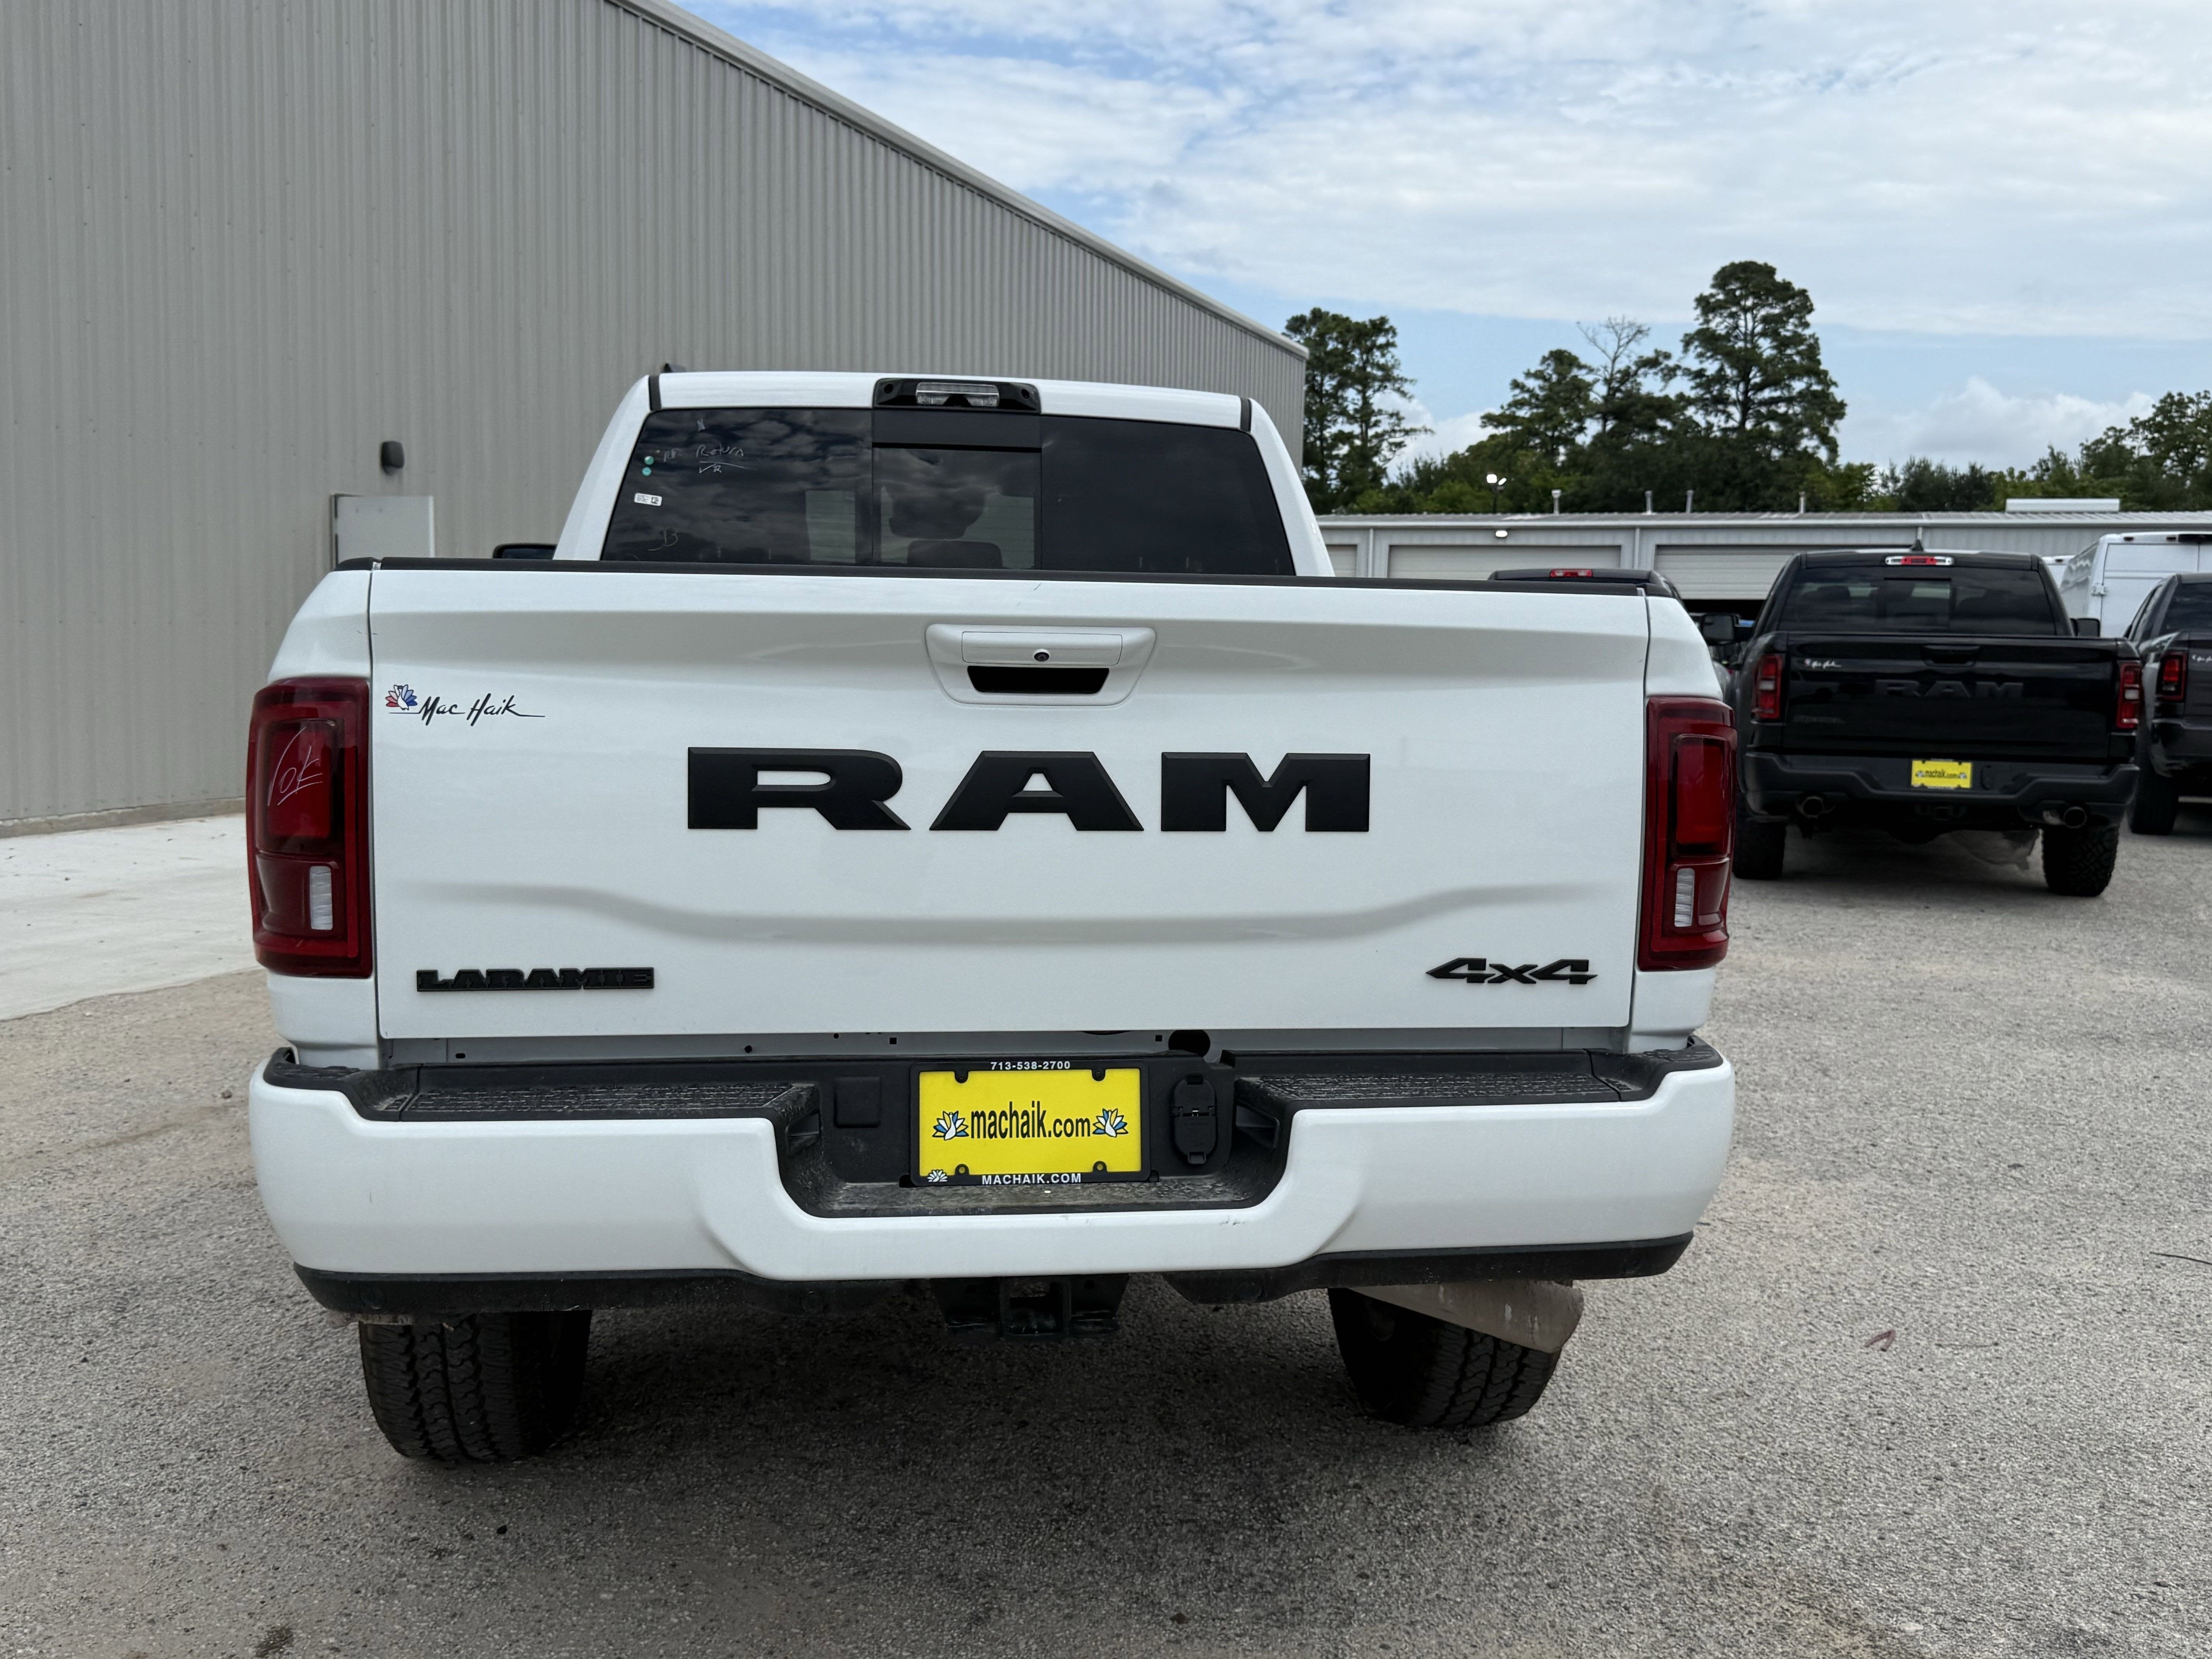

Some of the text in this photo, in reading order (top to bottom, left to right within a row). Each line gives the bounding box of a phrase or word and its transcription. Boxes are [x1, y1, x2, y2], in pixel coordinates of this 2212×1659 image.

[1875, 679, 2023, 697] RAM
[420, 693, 529, 726] Mac Haik
[688, 746, 1371, 833] RAM
[416, 967, 654, 992] LARAMIE
[1425, 957, 1599, 984] 4x4
[991, 1061, 1071, 1070] 713-538-2700
[970, 1101, 1091, 1139] machaik.com
[981, 1173, 1082, 1185] MACHAIK.COM
